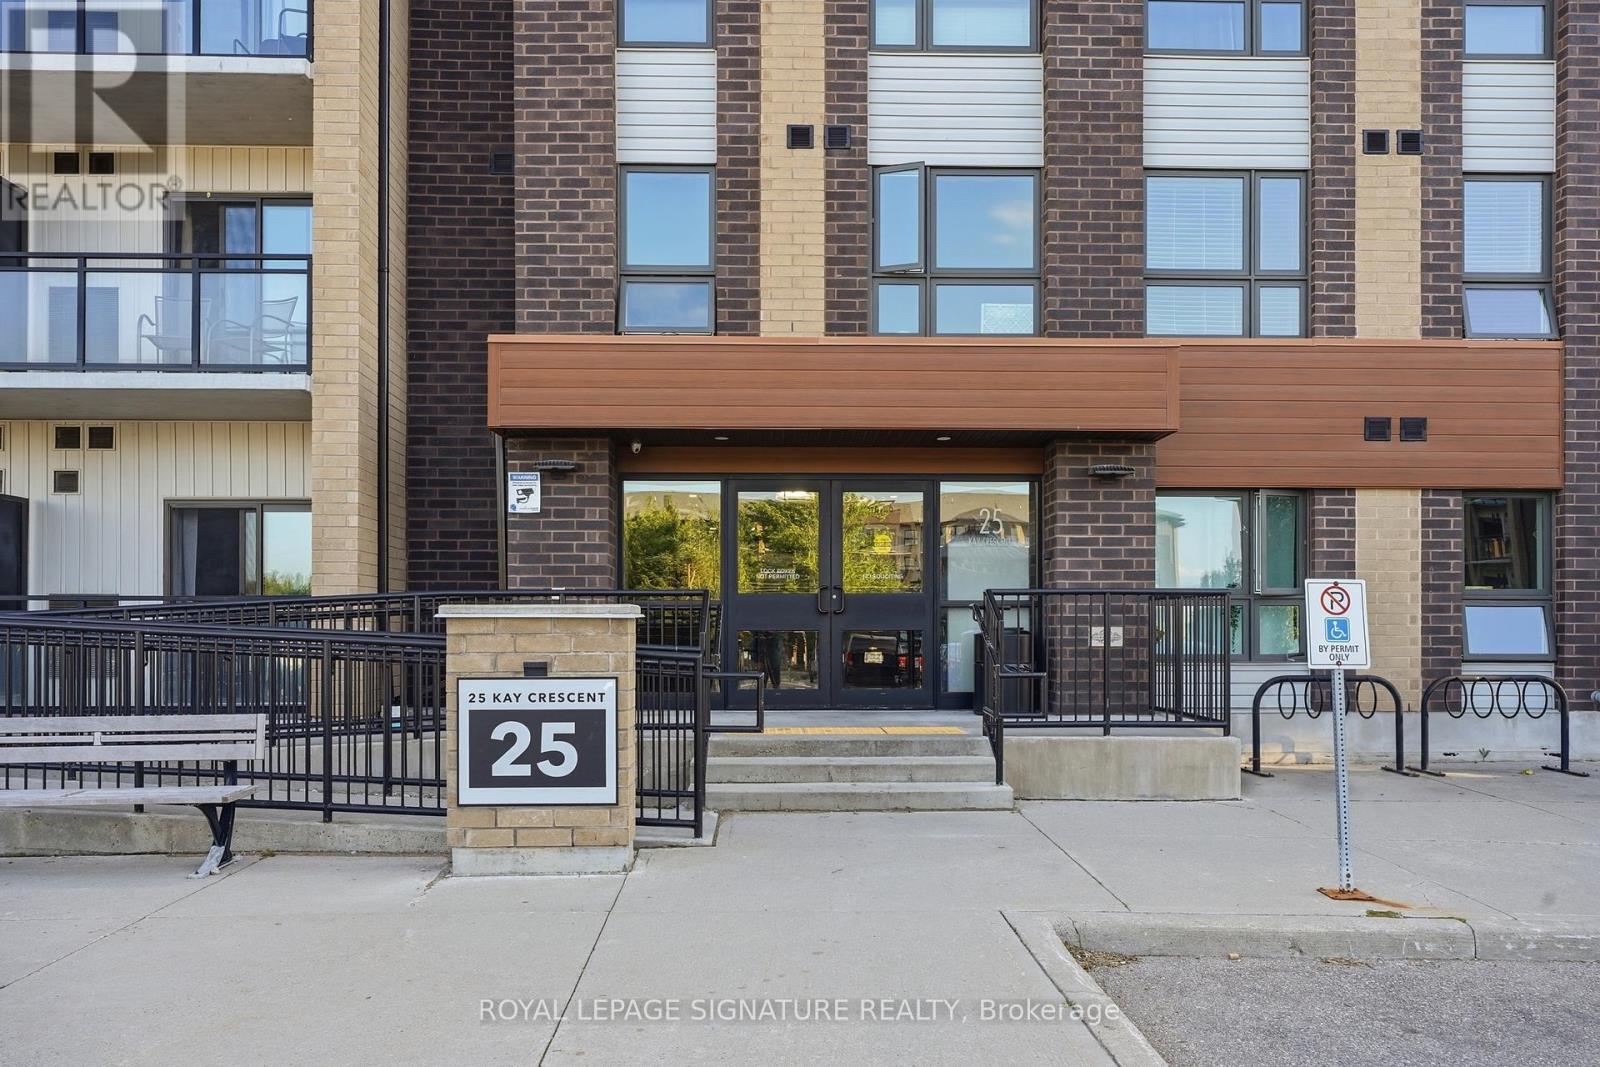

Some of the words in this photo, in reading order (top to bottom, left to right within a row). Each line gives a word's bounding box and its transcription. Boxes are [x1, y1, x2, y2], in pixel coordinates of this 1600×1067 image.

[979, 508, 1003, 534] 25
[1319, 645, 1329, 653] BY
[1331, 645, 1360, 653] PERMIT
[1329, 653, 1350, 661] ONLY
[468, 693, 486, 703] 25
[493, 693, 522, 703] KAY
[528, 692, 606, 703] CRESCENT
[490, 721, 578, 778] 25
